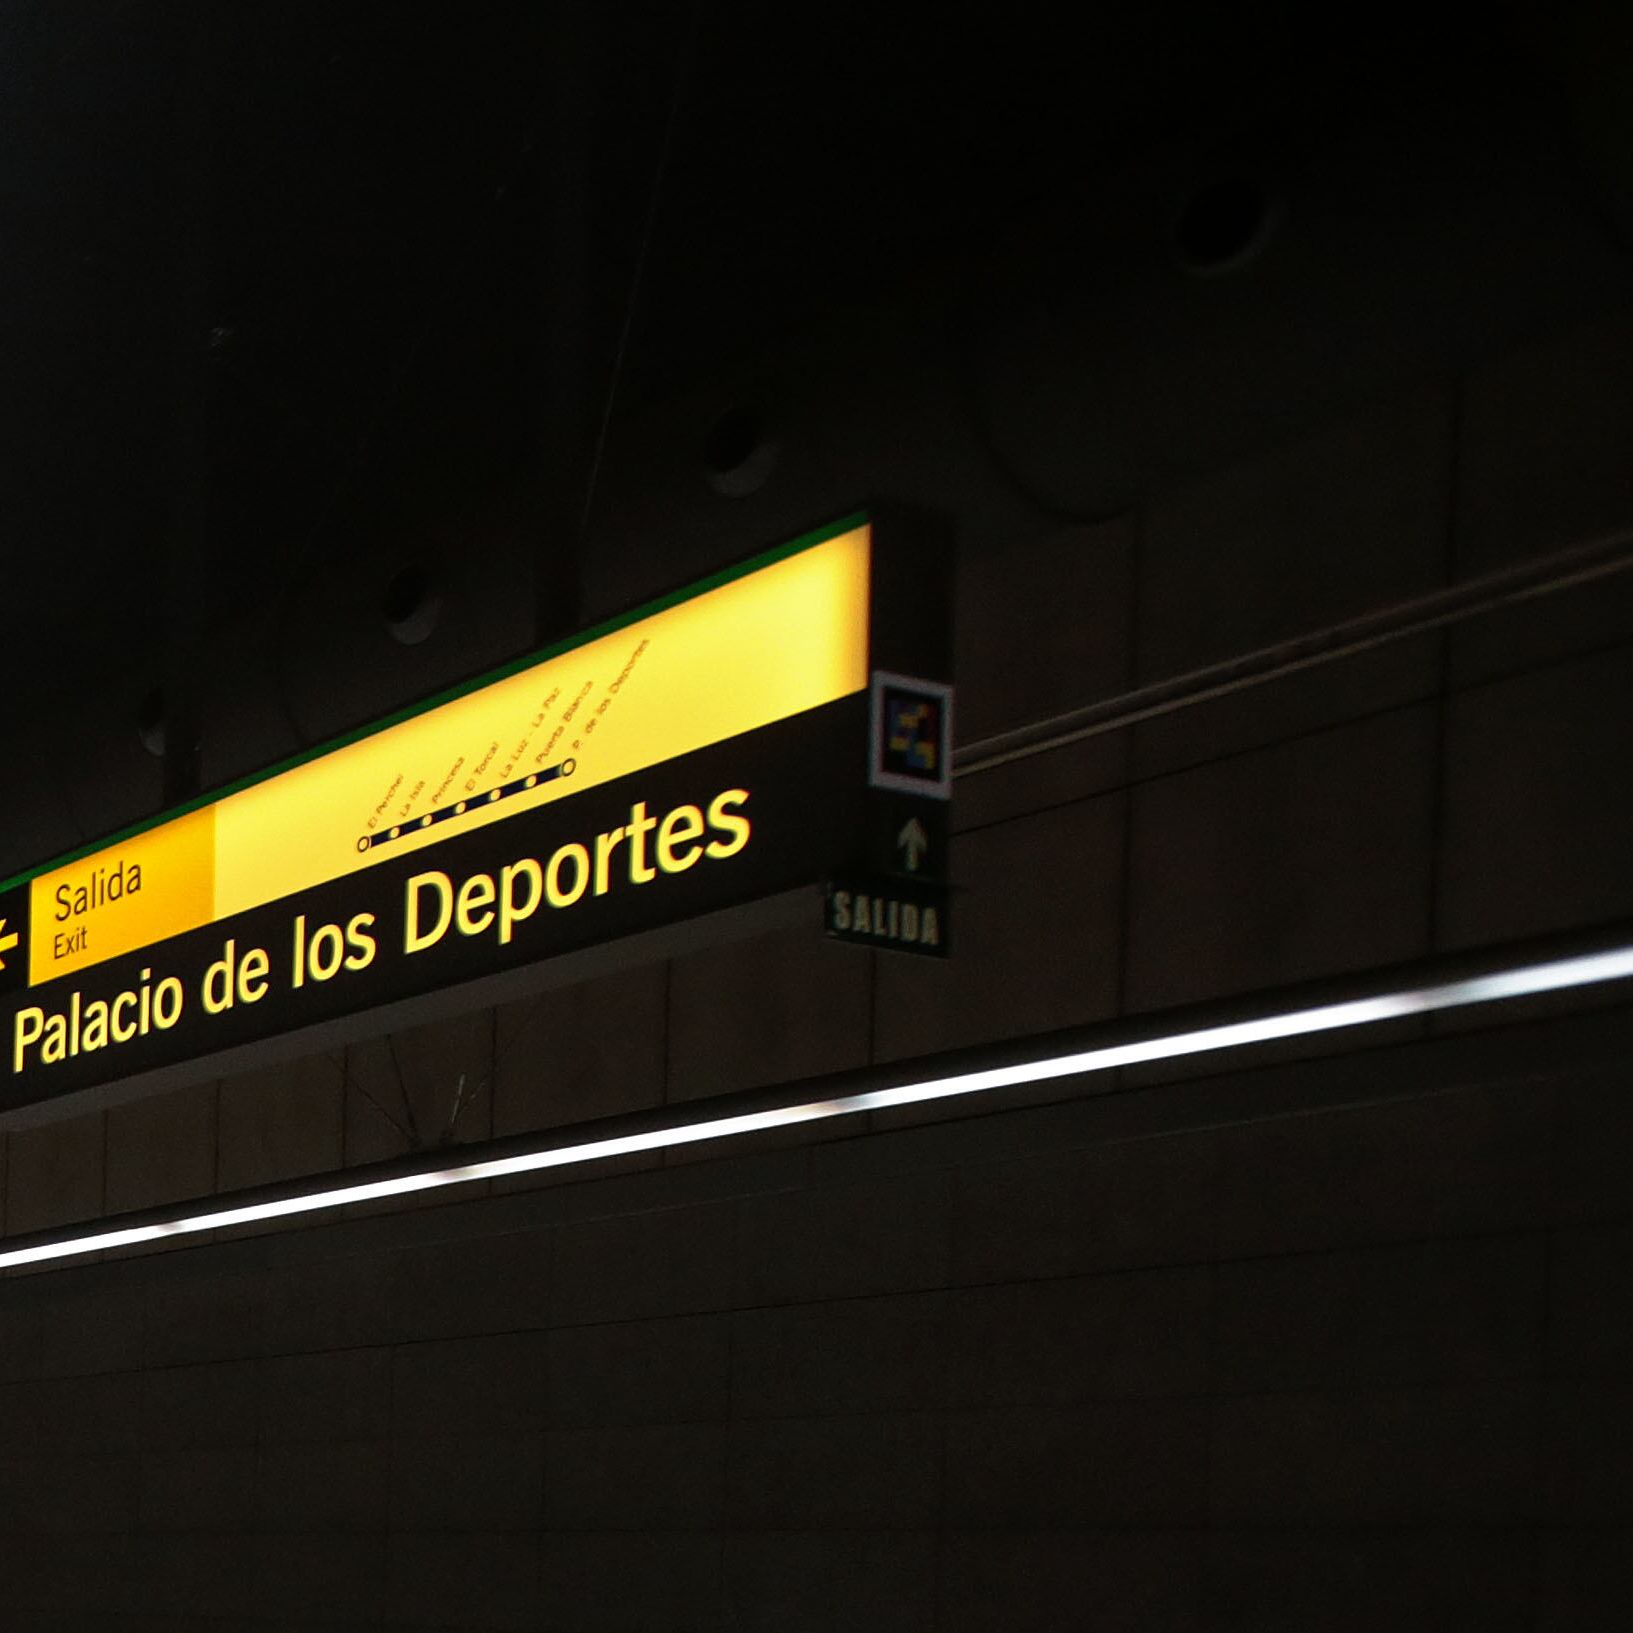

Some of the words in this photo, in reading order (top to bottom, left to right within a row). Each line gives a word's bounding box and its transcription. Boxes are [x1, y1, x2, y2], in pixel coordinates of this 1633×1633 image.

[608, 638, 650, 694] Deportes
[500, 763, 513, 779] La
[531, 711, 545, 728] La
[536, 725, 565, 765] Puerta
[563, 680, 594, 723] Blanca
[431, 756, 465, 805] Princesa
[474, 740, 500, 777] Torcal
[54, 860, 142, 923] Salida
[833, 890, 939, 946] SALIDA
[13, 967, 184, 1074] Palacio
[202, 938, 270, 1015] de
[292, 912, 377, 989] los
[403, 788, 751, 955] Deportes
[52, 926, 88, 961] Exit
